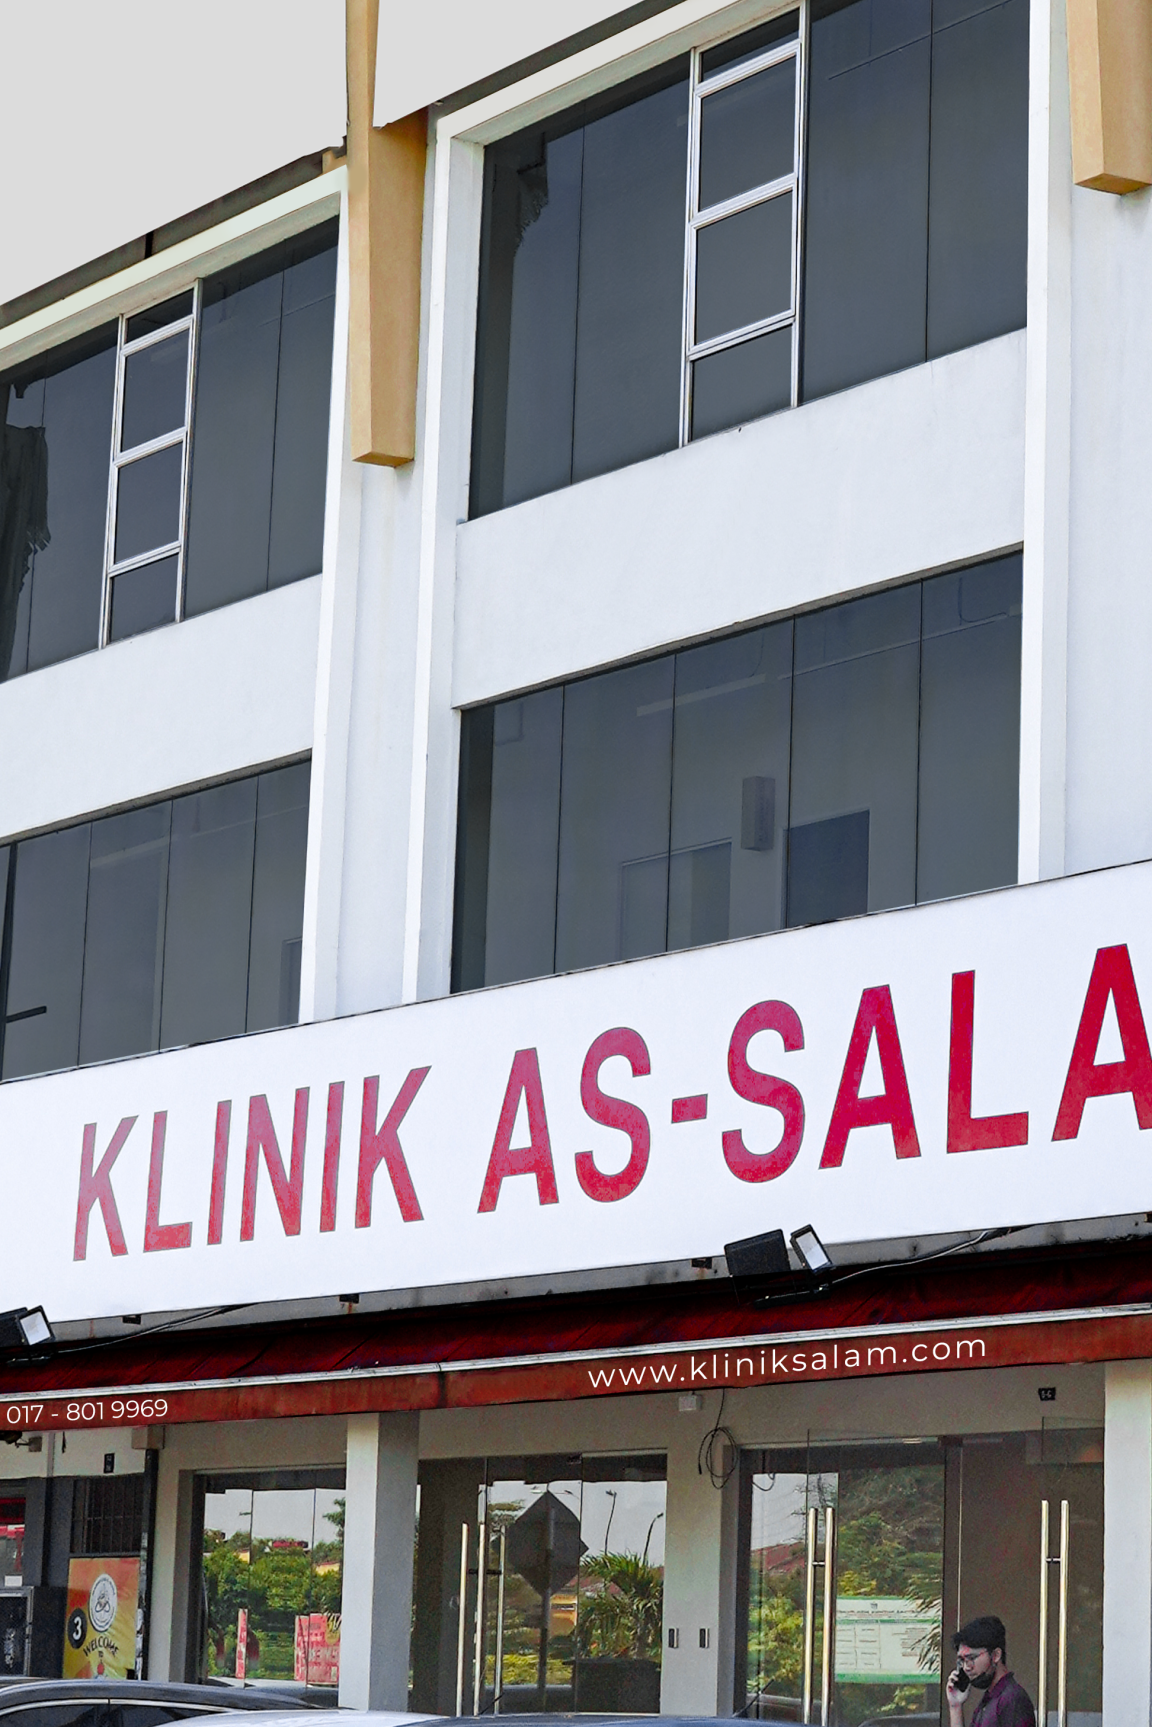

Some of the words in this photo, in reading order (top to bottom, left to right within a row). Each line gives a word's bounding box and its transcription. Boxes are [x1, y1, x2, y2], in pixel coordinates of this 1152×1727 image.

[73, 1065, 431, 1262] KLINIK
[587, 1338, 986, 1388] www.kliniksalam.com
[6, 1404, 44, 1424] 017
[66, 1402, 104, 1421] 801
[111, 1398, 168, 1419] 9969
[72, 1616, 82, 1640] 3
[83, 1635, 120, 1658] WELCOME
